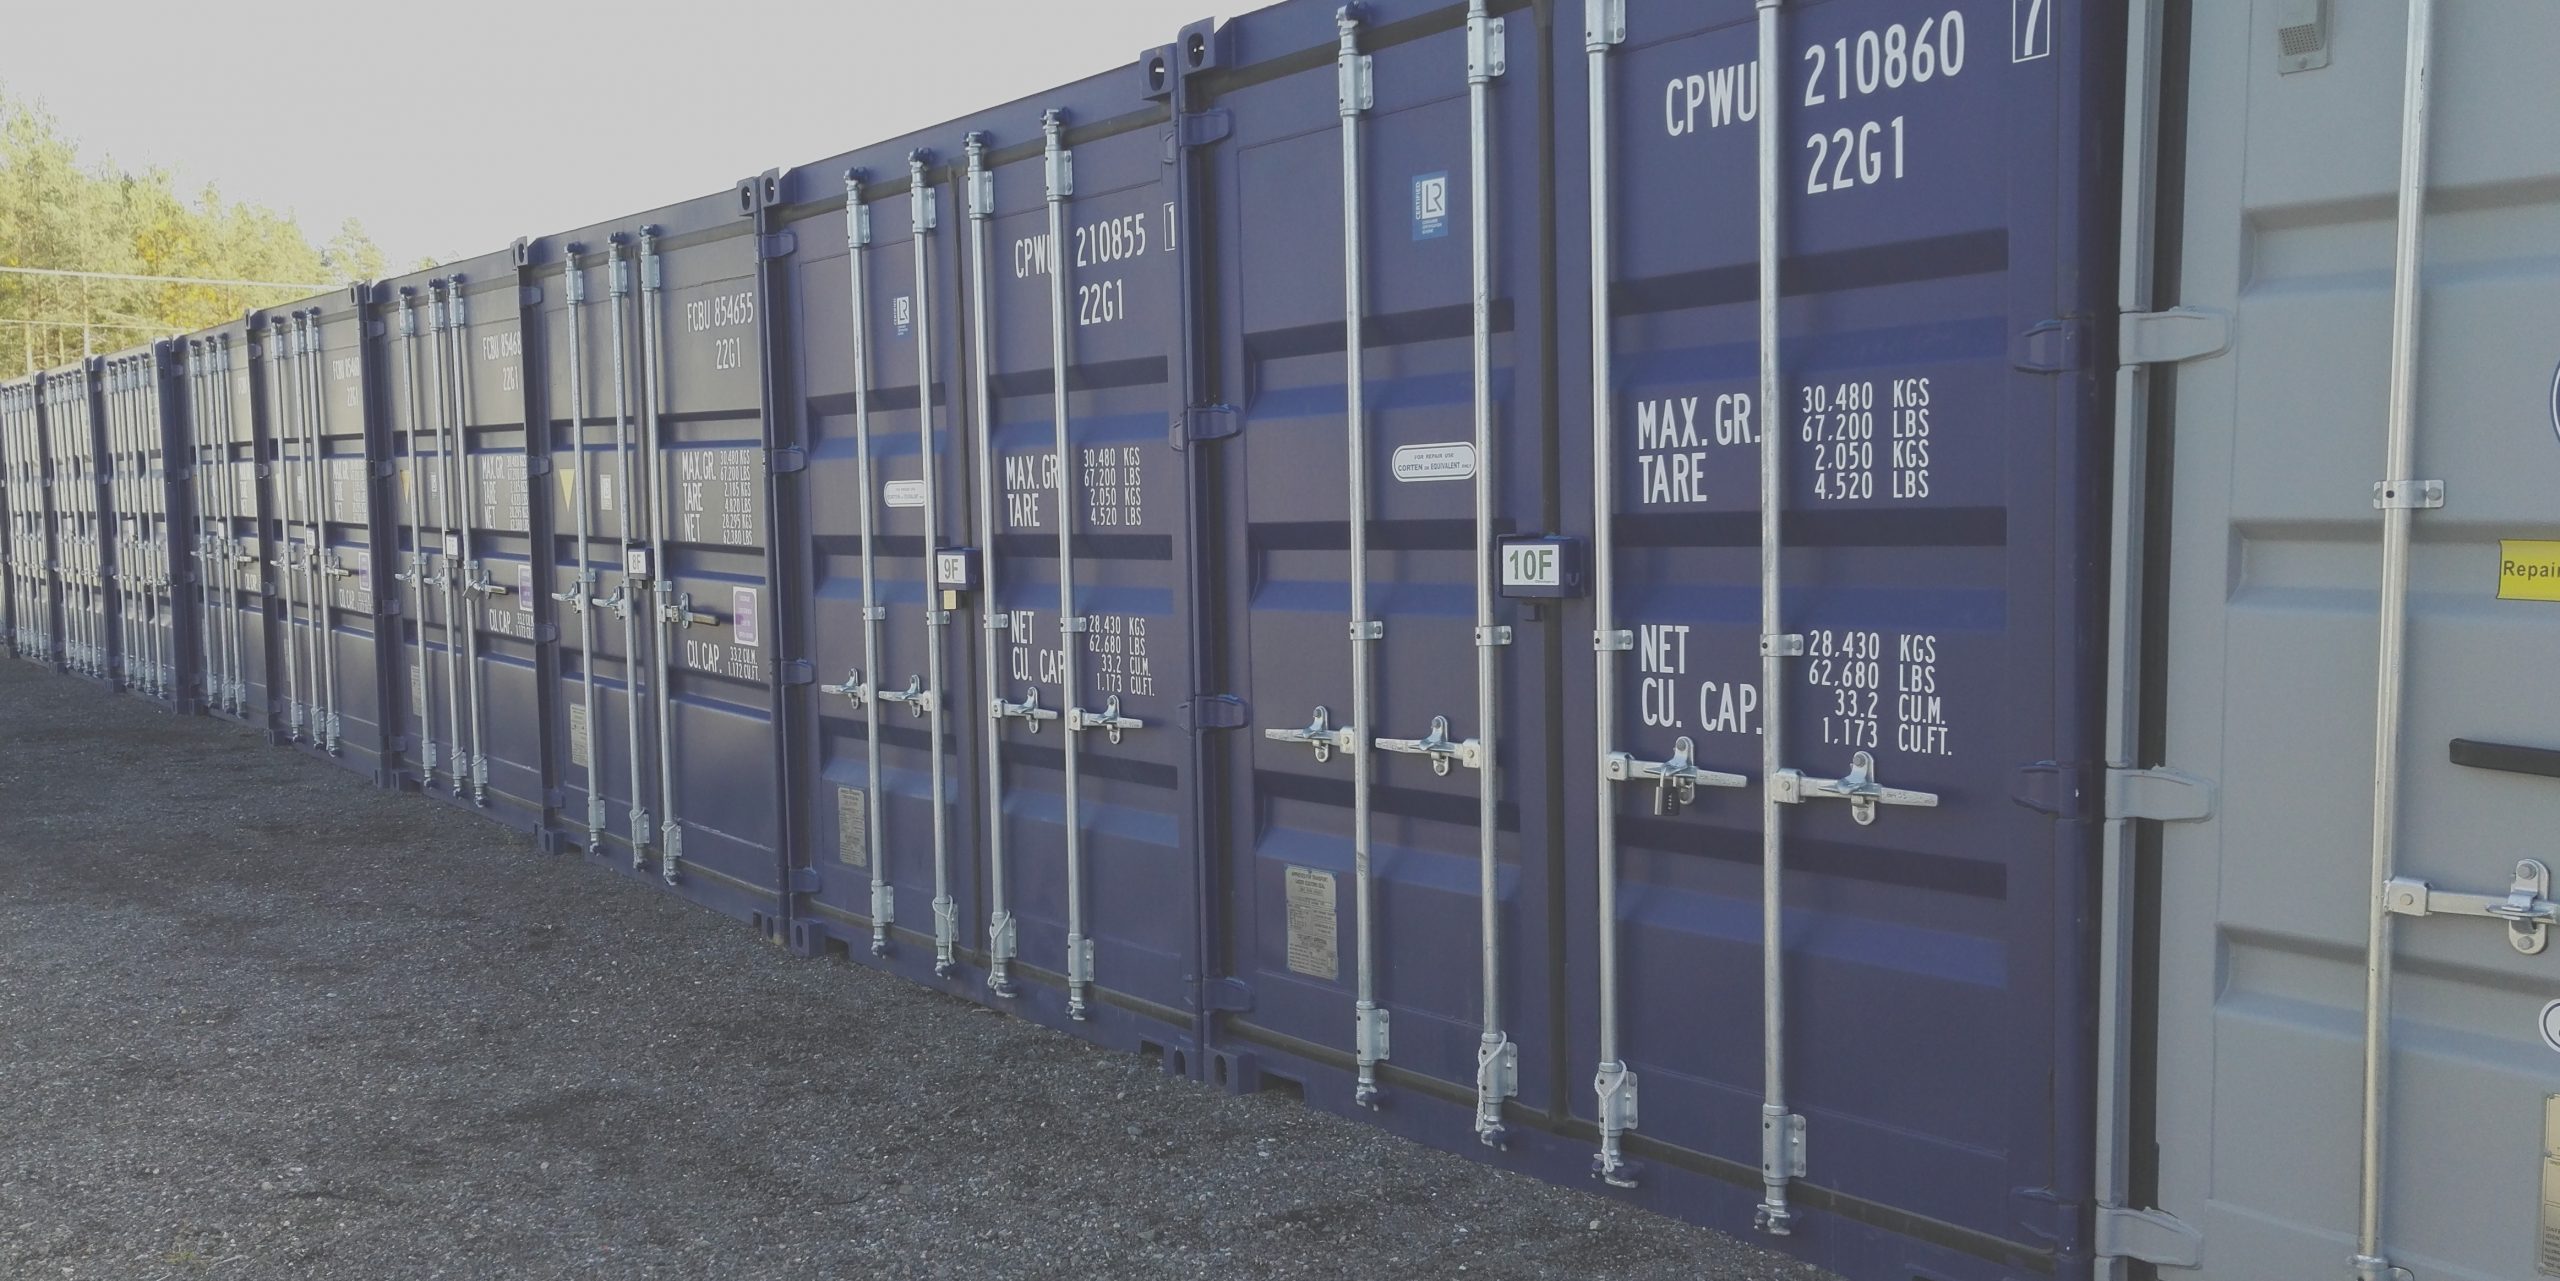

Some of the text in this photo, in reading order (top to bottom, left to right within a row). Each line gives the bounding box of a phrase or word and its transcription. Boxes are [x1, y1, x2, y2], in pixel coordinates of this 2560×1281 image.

[1665, 60, 1758, 137] CPWU
[1804, 10, 1965, 107] 210860
[1806, 116, 1904, 195] 22G1
[1076, 213, 1146, 268] 210855
[1168, 204, 1176, 248] 1
[687, 292, 754, 333] FCBU 854655
[1079, 279, 1123, 326] 22G1
[716, 337, 741, 370] 22G1
[1802, 378, 1930, 414] 30,480 KGS
[1638, 393, 1761, 450] MAX. GR.
[1802, 408, 1930, 442] 67,200 LBS
[682, 451, 702, 480] MAX.
[1124, 446, 1140, 466] KGS
[1815, 439, 1929, 471] 2,050 KGS
[1006, 456, 1040, 490] MAX.
[1124, 467, 1141, 486] LBS
[1638, 452, 1708, 504] TARE
[1814, 470, 1929, 500] 4,520 LBS
[682, 482, 704, 512] TARE
[1008, 493, 1040, 527] TARE
[1124, 487, 1141, 506] KGS
[684, 514, 701, 542] NET
[1126, 507, 1142, 526] LBS
[944, 558, 959, 580] 9F
[1509, 550, 1553, 581] 10F
[1011, 610, 1035, 645] NET
[1129, 616, 1146, 636] KGS
[687, 640, 702, 670] CU.
[1130, 636, 1146, 656] LBS
[1640, 624, 1690, 674] NET
[1809, 630, 1936, 664] 28,430 KGS
[1012, 646, 1033, 682] CU.
[1102, 654, 1122, 674] 33.2
[1808, 658, 1936, 694] 62,680 LBS
[1641, 677, 1764, 735] CU. CAP.
[1834, 688, 1946, 725] 33.2 CU.M.
[1823, 716, 1952, 756] 1,173 CU.FT.
